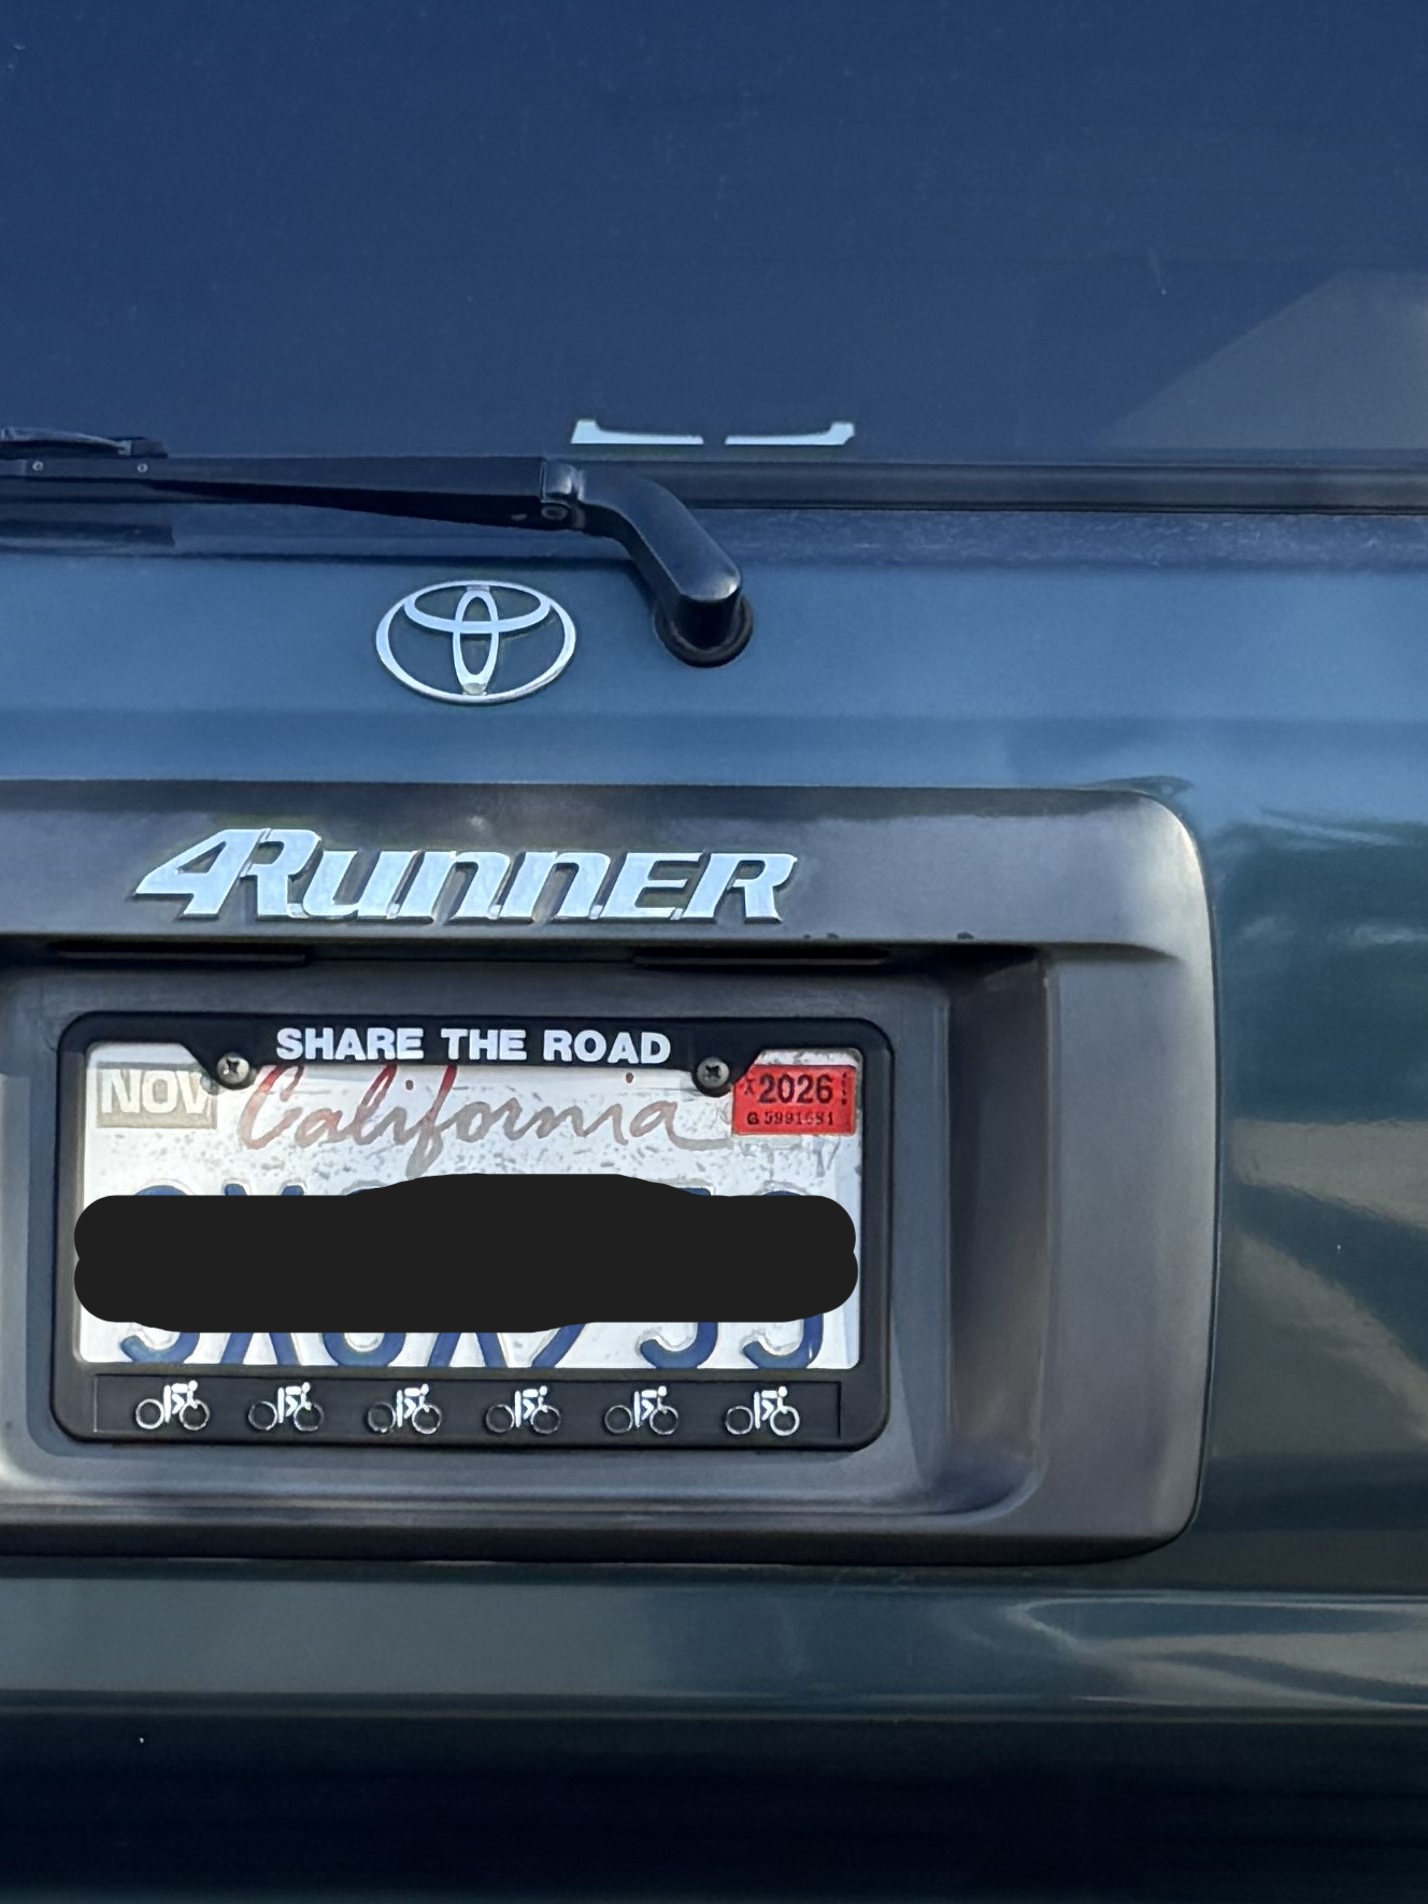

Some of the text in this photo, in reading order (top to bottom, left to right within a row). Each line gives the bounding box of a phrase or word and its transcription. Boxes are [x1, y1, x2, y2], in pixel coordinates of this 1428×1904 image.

[275, 1027, 672, 1064] SHARE THE ROAD
[101, 1068, 211, 1114] NOV
[758, 1073, 834, 1104] 2026
[239, 1065, 732, 1180] California
